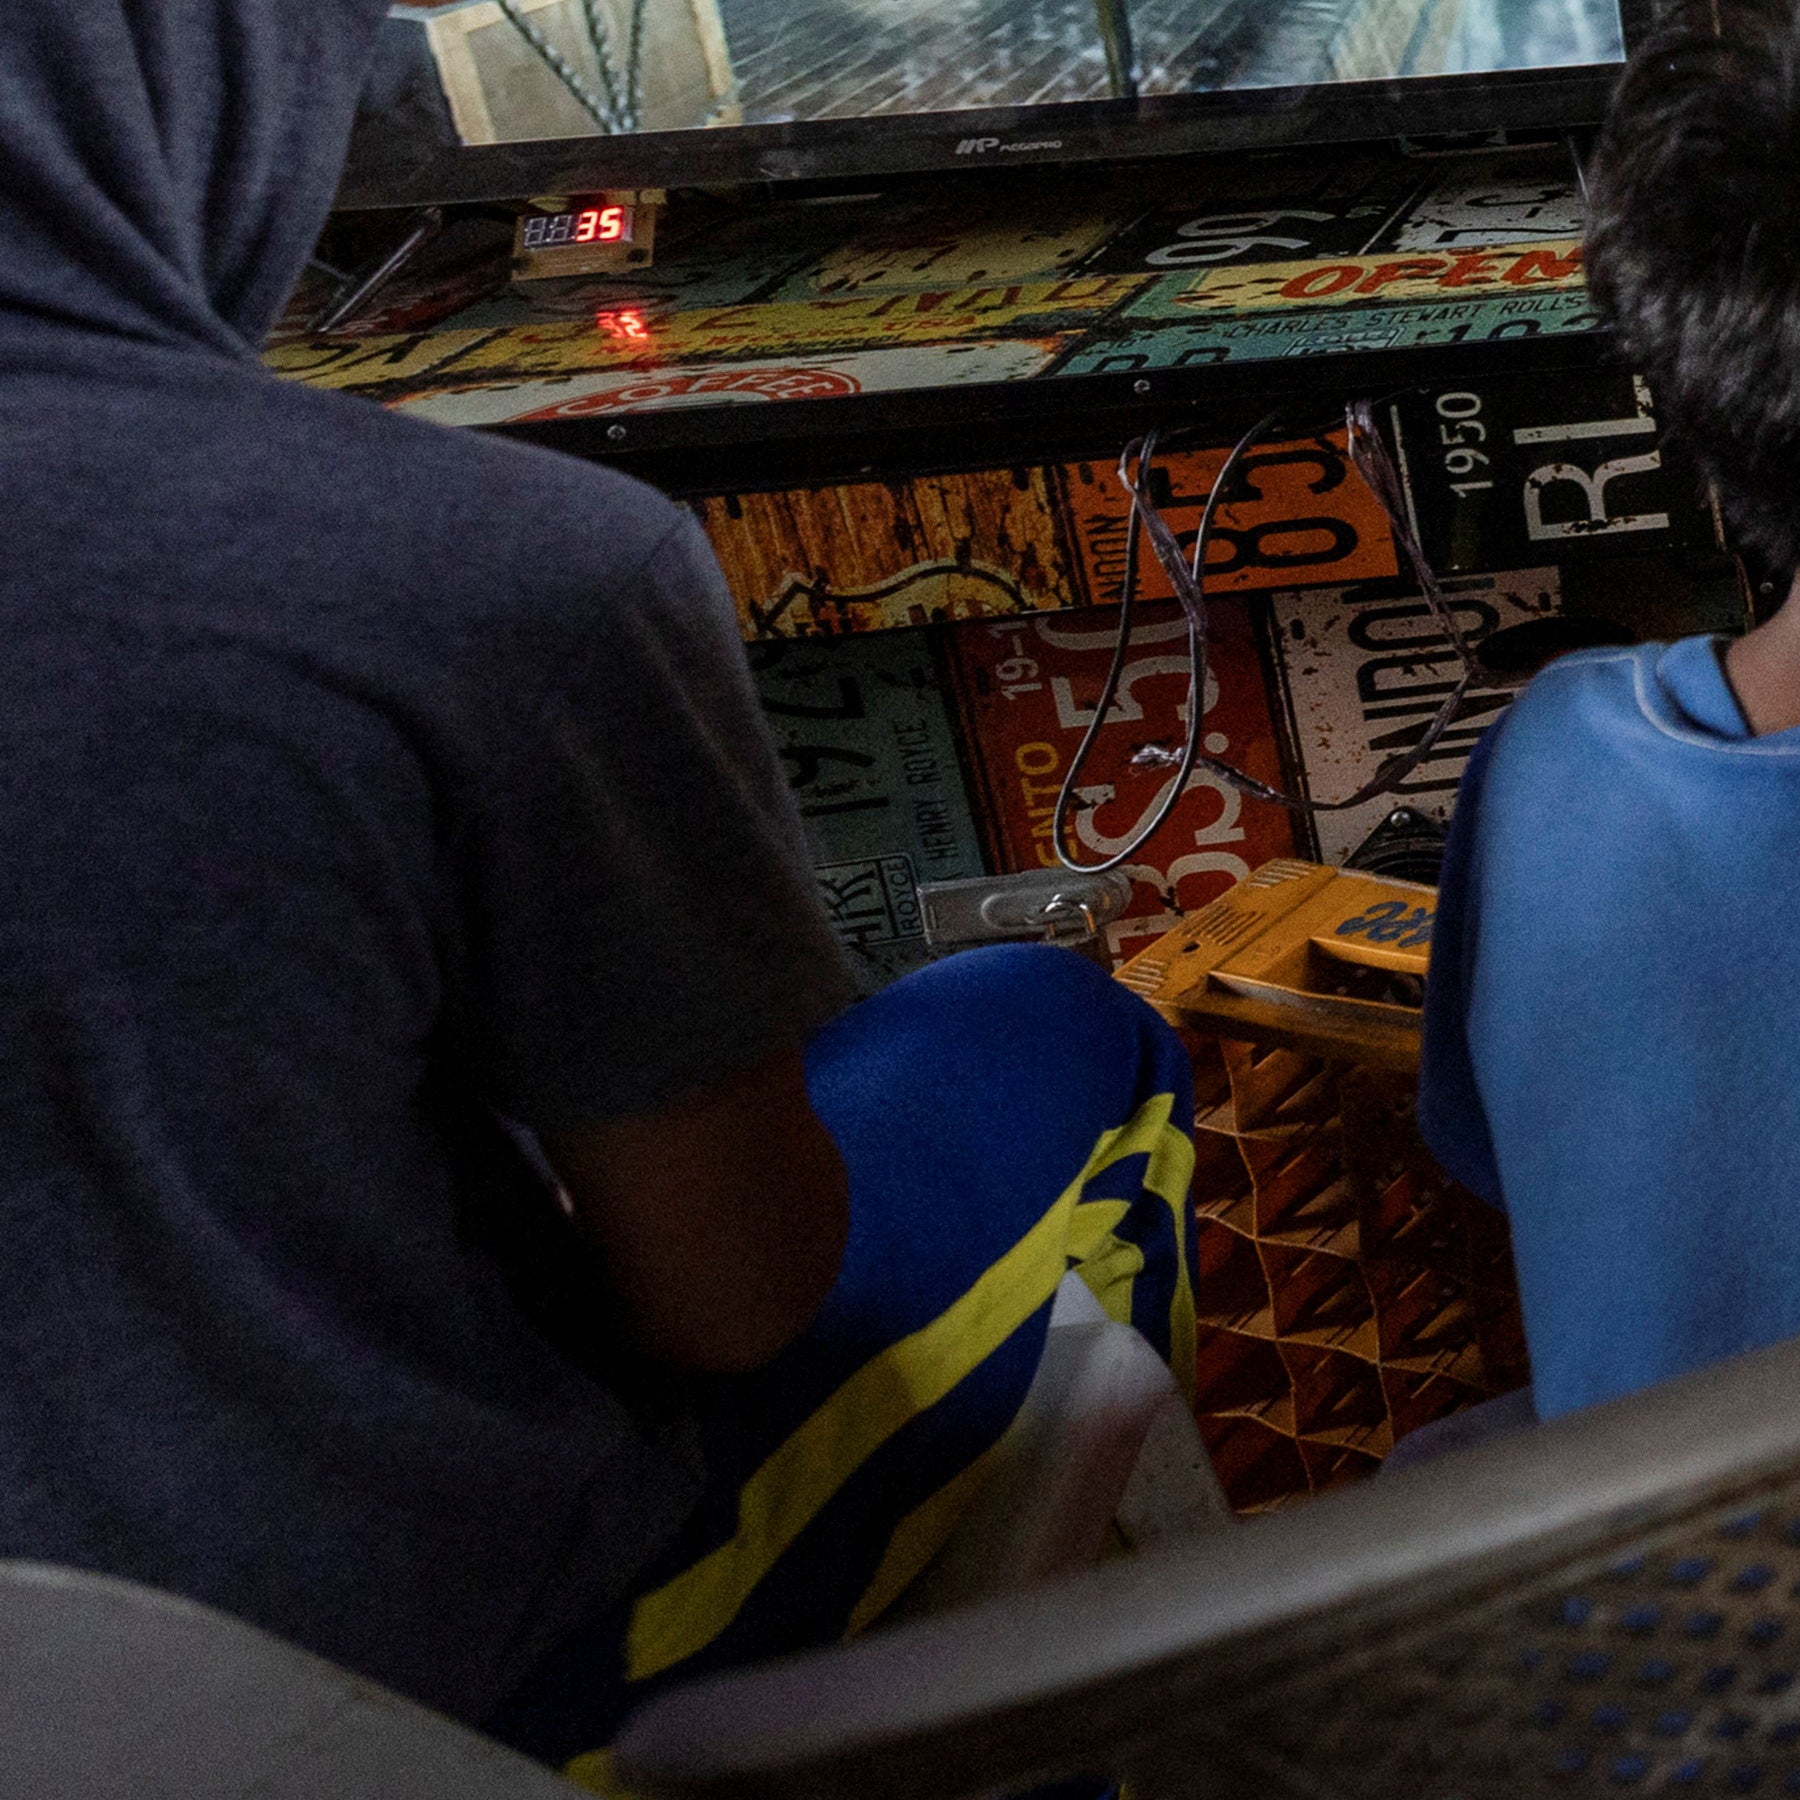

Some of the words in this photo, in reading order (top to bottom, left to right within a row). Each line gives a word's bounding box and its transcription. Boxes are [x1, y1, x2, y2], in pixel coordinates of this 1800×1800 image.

[576, 206, 625, 242] 35
[1280, 248, 1586, 299] OPEN
[1370, 303, 1484, 325] STEWART
[560, 369, 841, 414] COFFEE
[1436, 392, 1496, 499] 1950
[892, 716, 939, 788] ROYCE
[915, 794, 958, 862] HENRY
[887, 859, 919, 932] ROYCE
